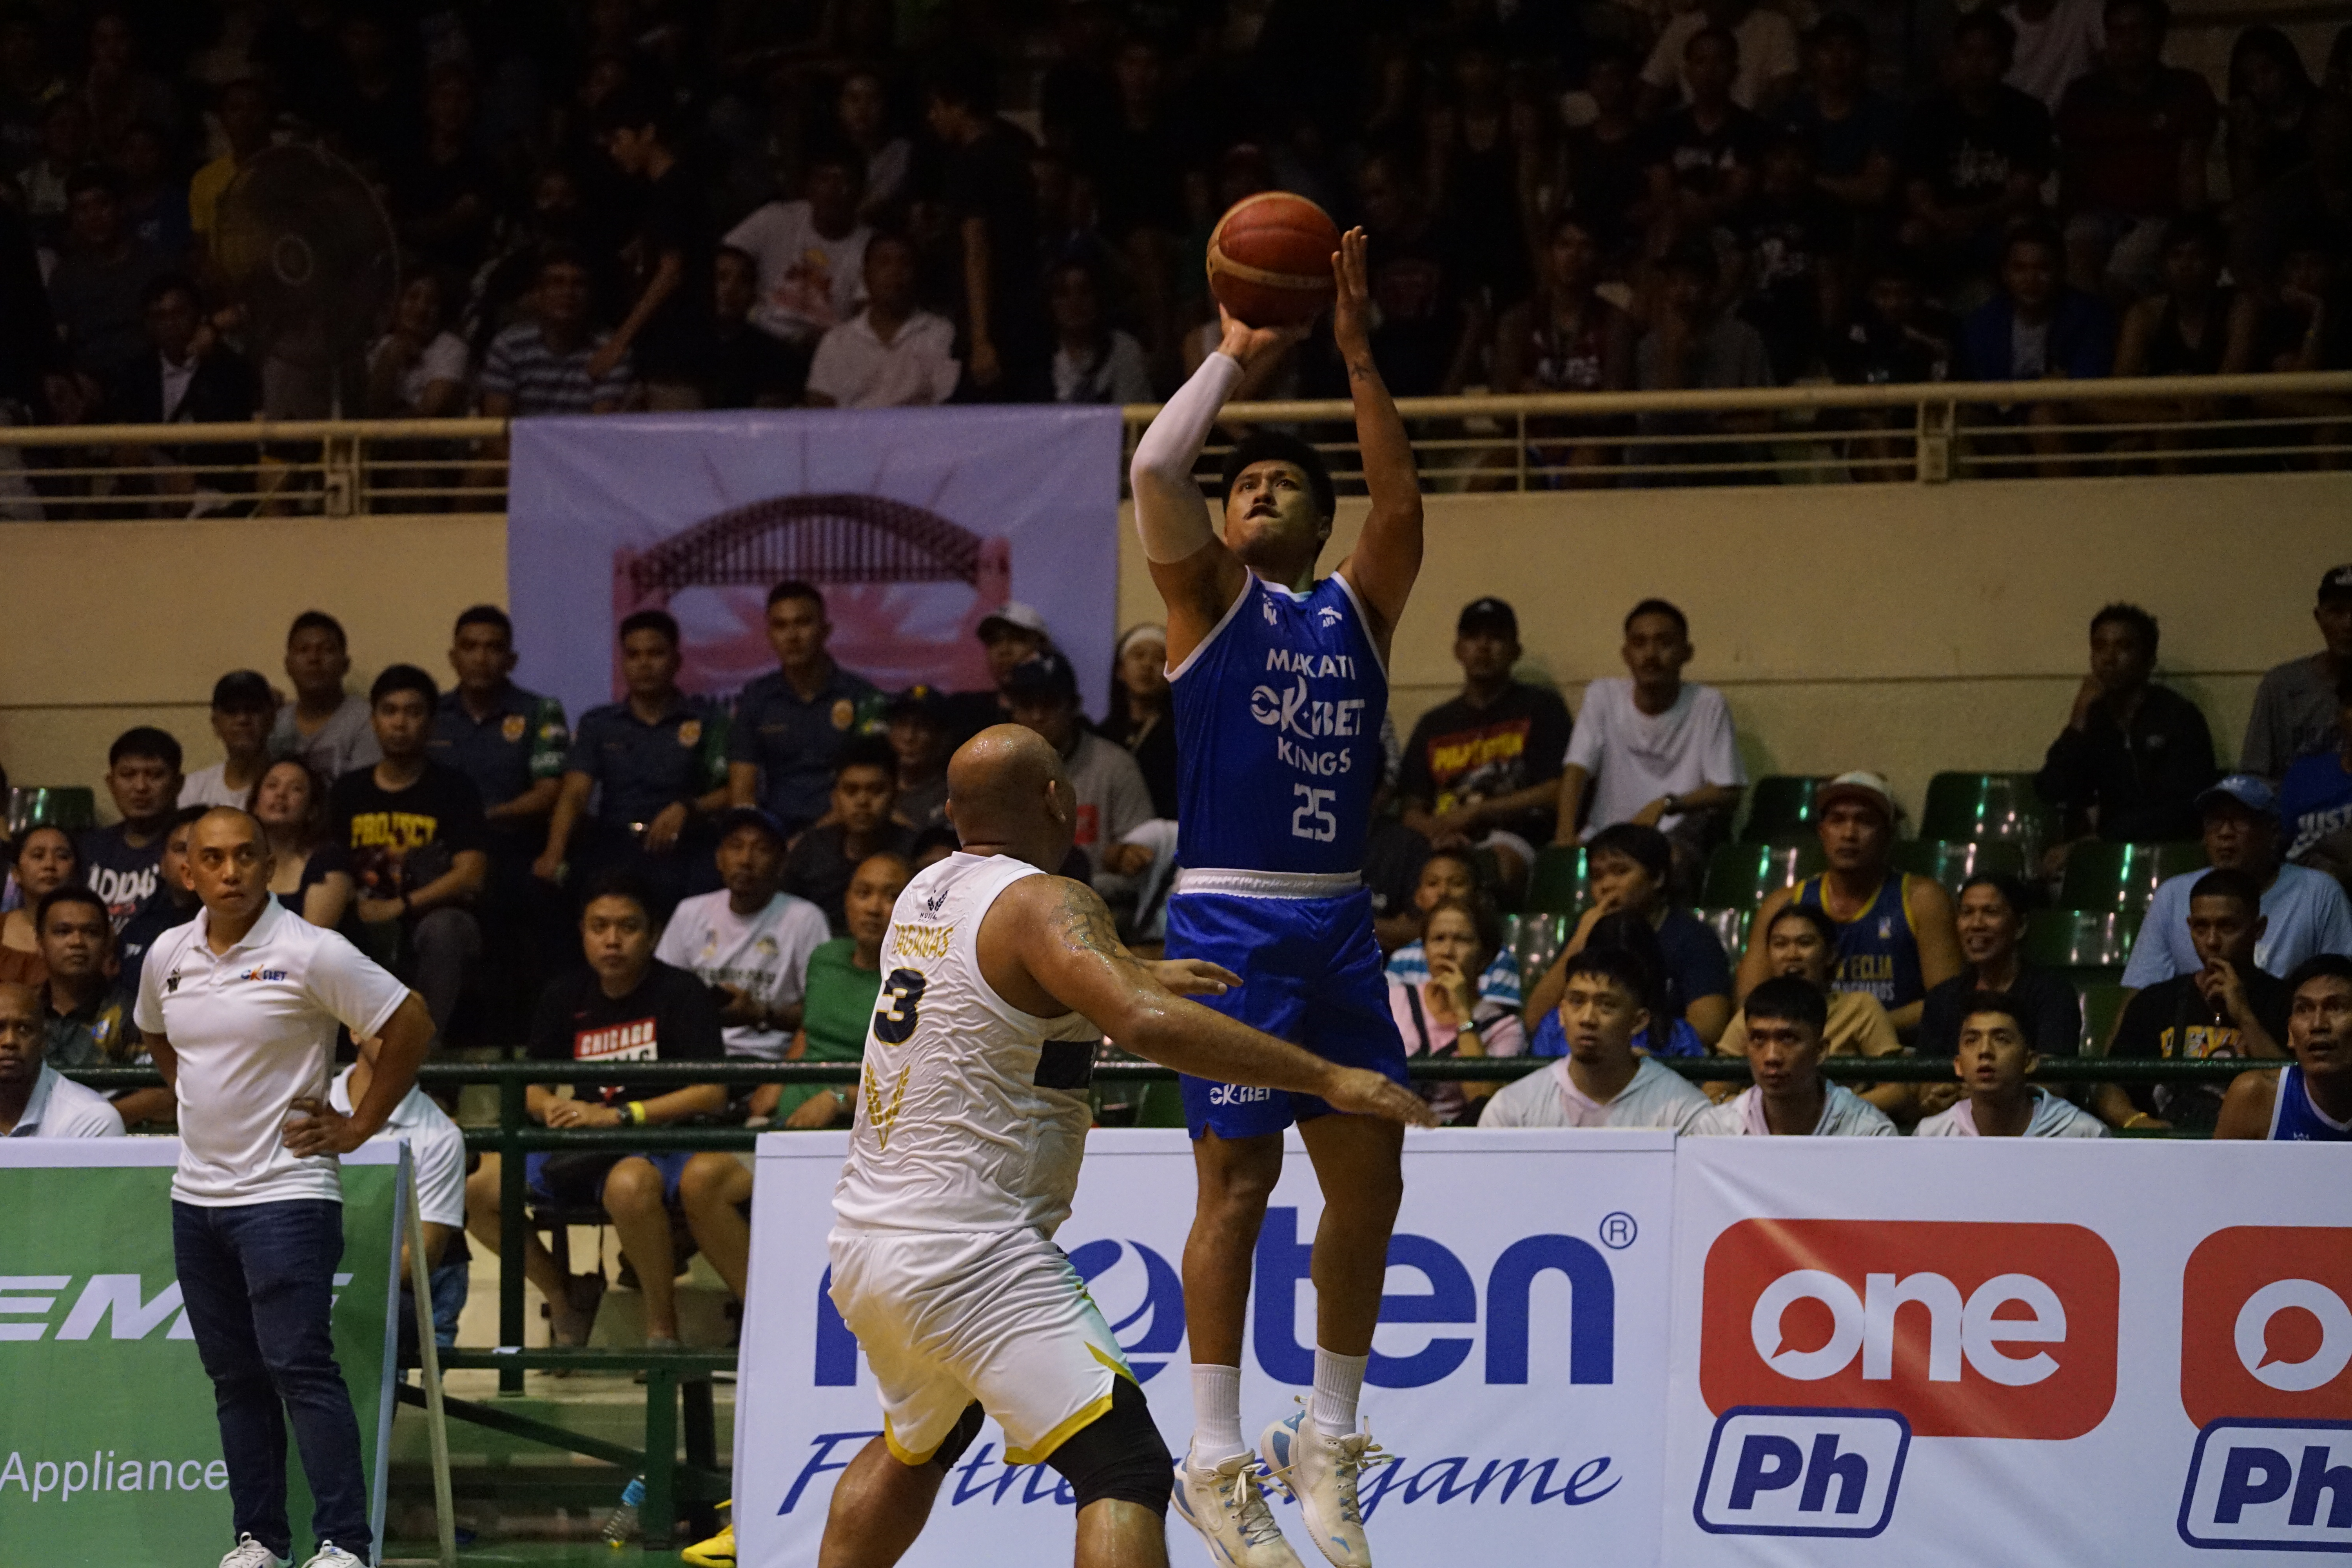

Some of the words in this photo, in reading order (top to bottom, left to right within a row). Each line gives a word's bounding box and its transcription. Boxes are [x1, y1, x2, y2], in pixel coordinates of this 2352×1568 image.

[1266, 648, 1356, 680] MAKATI
[1278, 735, 1351, 776] KINGS
[1292, 783, 1336, 842] 25
[580, 1021, 654, 1056] CHICAGO
[873, 966, 927, 1046] 3
[1751, 1269, 2067, 1387] one
[1357, 1456, 1622, 1525] game
[1728, 1433, 1869, 1514] Ph
[2213, 1445, 2352, 1528] Ph
